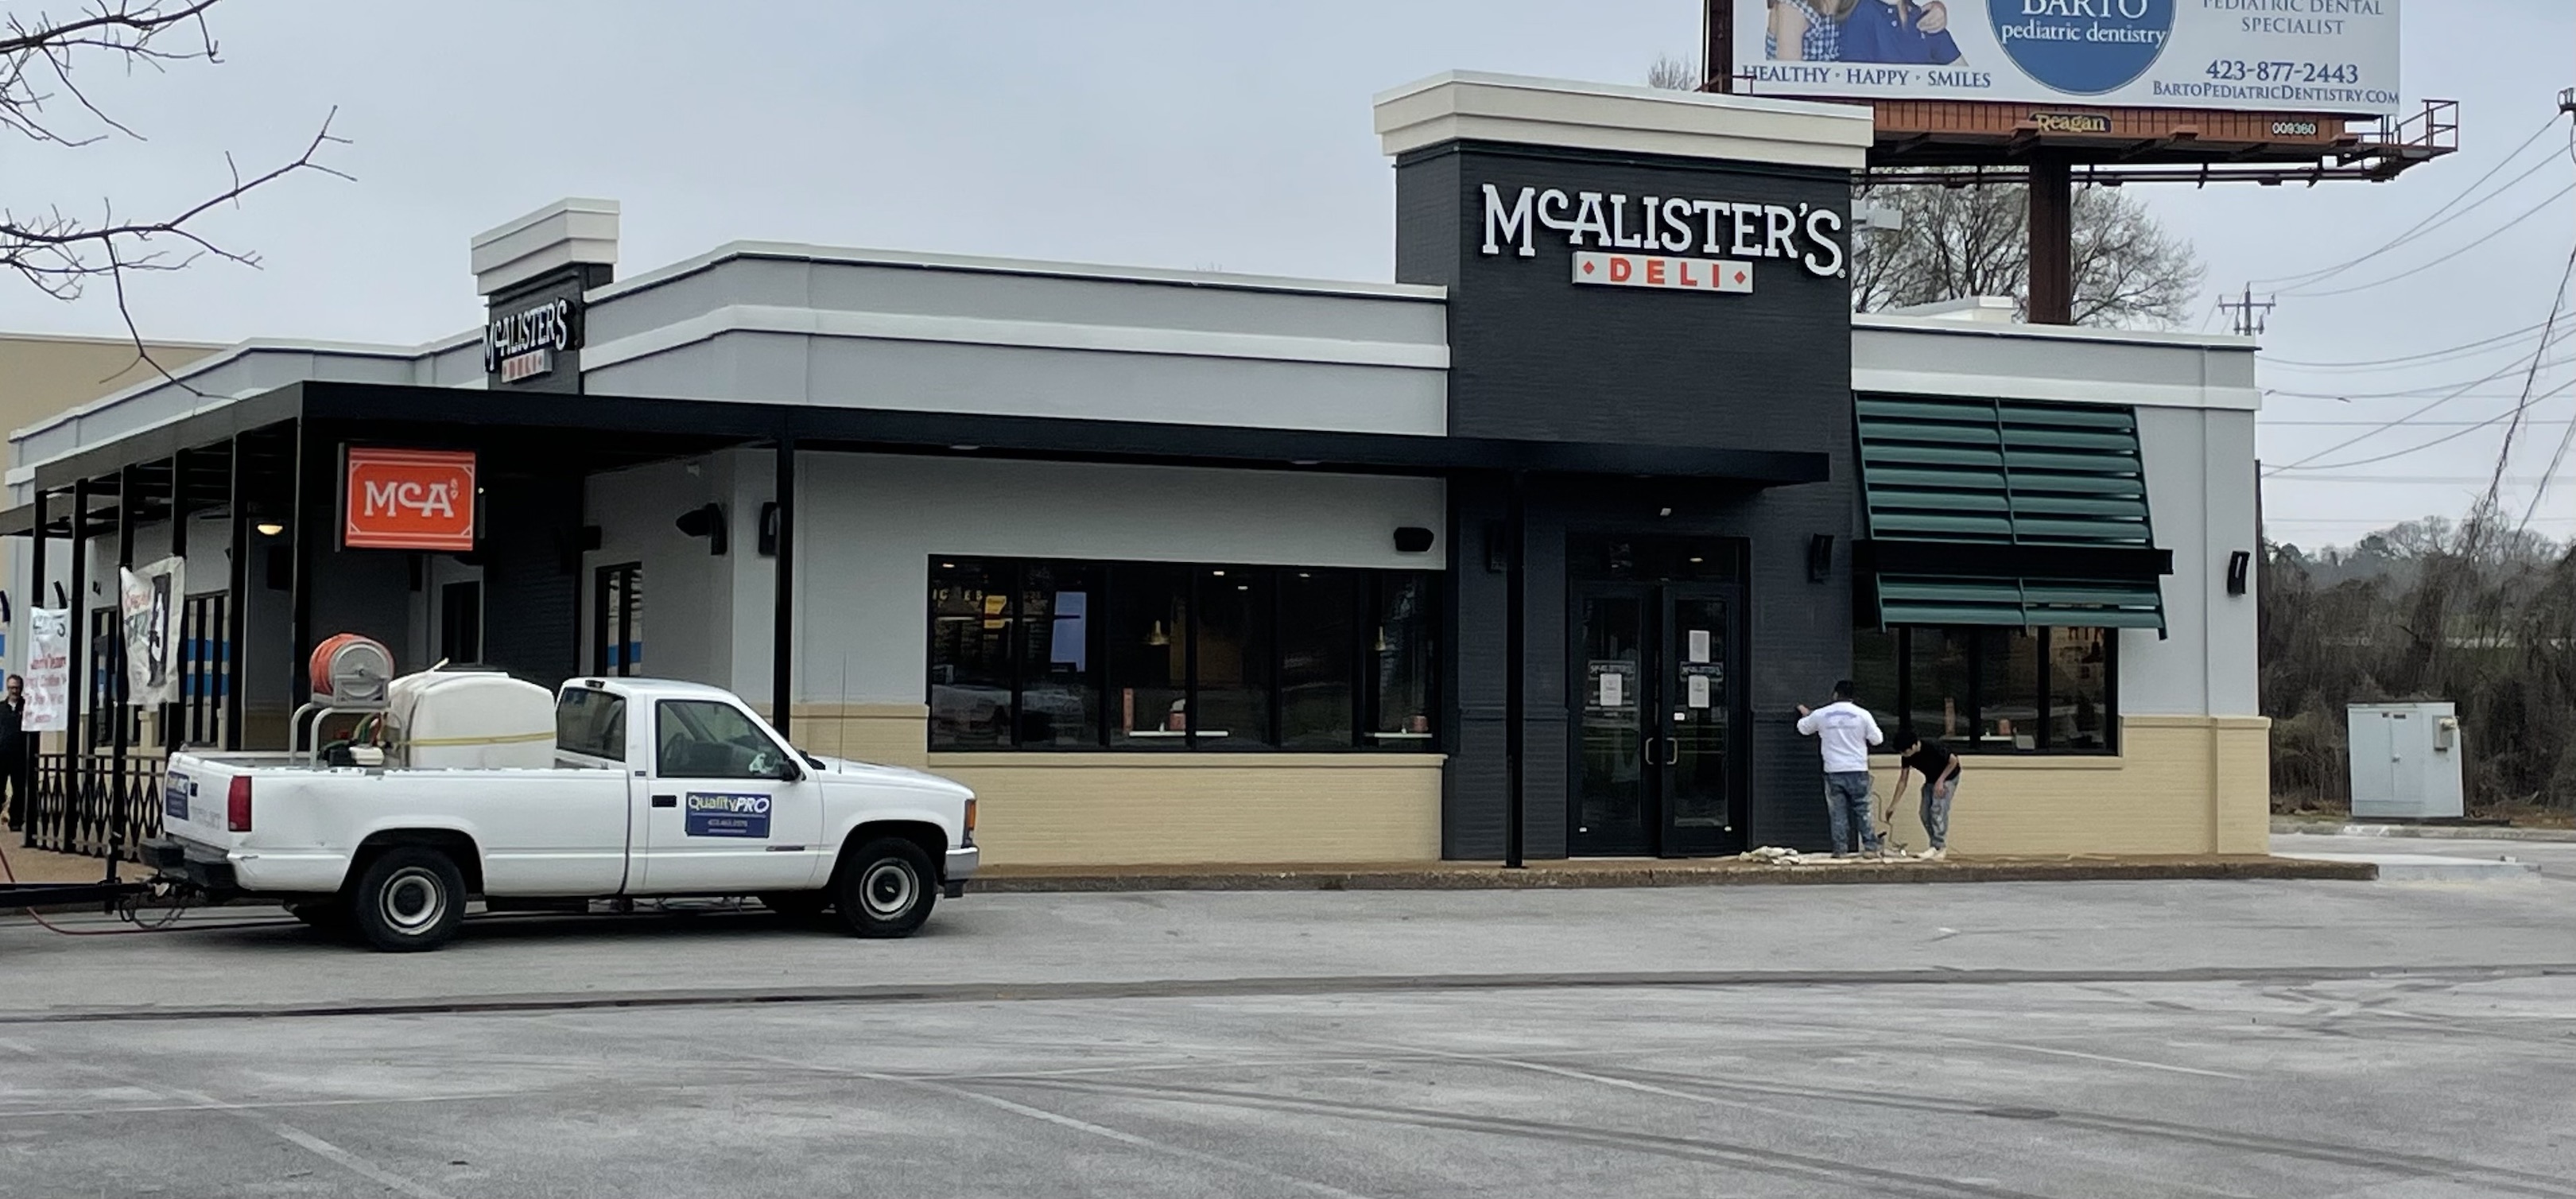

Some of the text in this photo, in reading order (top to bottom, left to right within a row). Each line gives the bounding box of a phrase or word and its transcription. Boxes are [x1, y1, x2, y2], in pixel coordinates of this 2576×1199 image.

[2309, 0, 2385, 14] DENTAL
[2000, 18, 2167, 49] pediatric dentistry
[2241, 17, 2346, 34] SPECIALIST
[1742, 65, 1992, 88] HEALTHY HAPPY SMILES
[2206, 60, 2359, 83] 423-877-2443
[2035, 114, 2106, 133] Reagan
[1610, 257, 1721, 289] DELI
